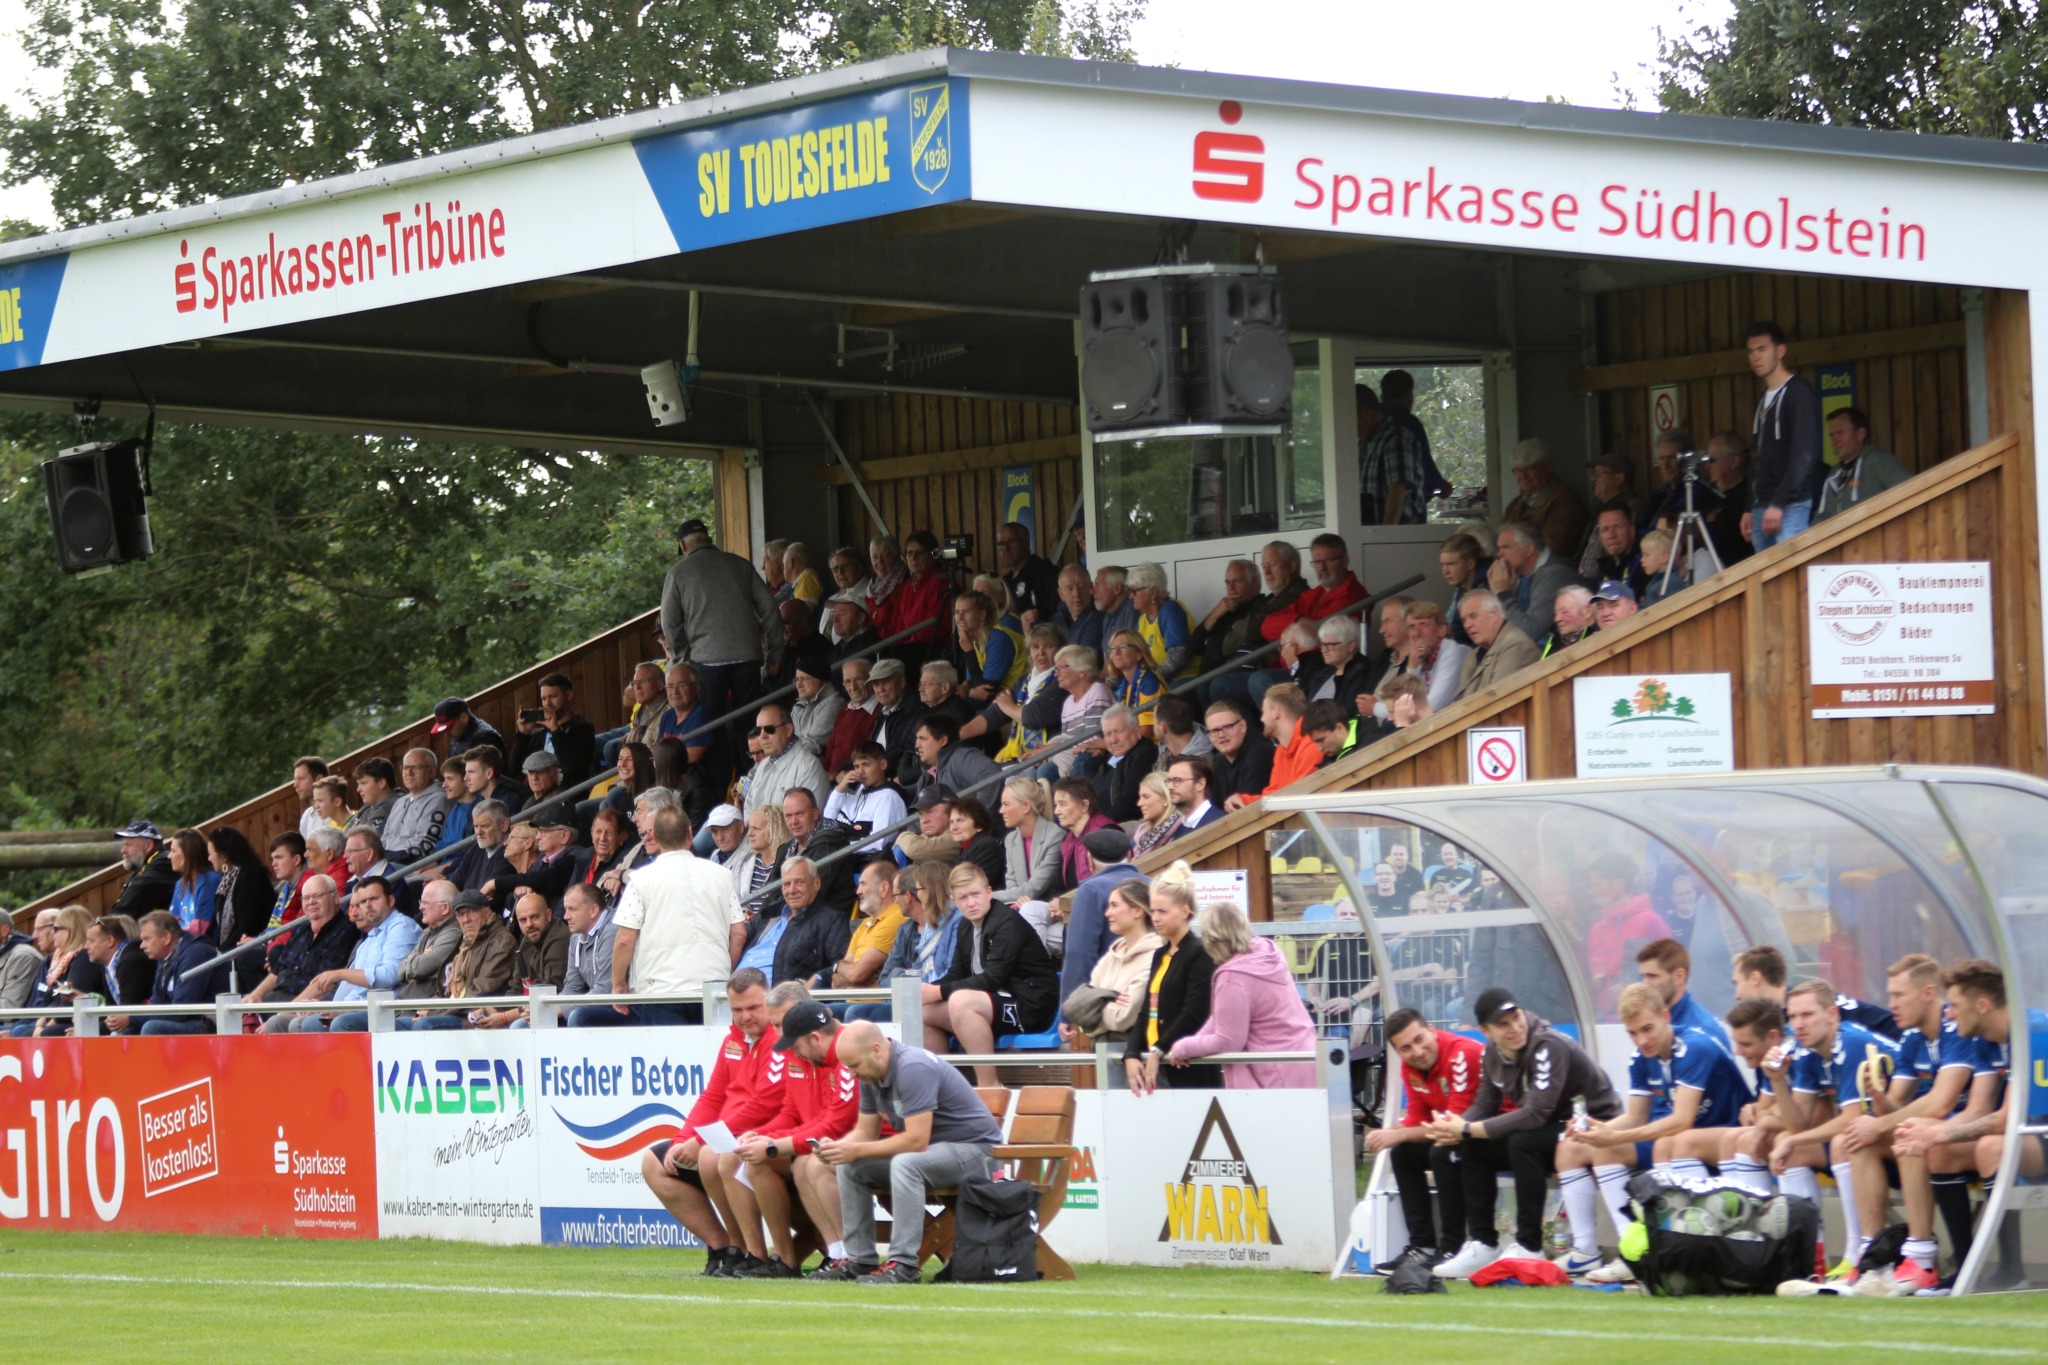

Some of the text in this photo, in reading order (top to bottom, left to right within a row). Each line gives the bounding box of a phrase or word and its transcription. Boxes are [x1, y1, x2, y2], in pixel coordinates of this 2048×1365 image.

[913, 96, 928, 118] SV
[912, 97, 947, 158] TODESFELDE
[698, 117, 890, 218] SV TODESFELDE
[924, 148, 947, 171] 1928
[1293, 157, 1927, 262] Sparkasse Südholstein
[203, 200, 506, 323] Sparkassen-Tribüne
[1007, 473, 1029, 487] Block
[1898, 575, 1984, 590] Bauklempnerei
[1818, 605, 1853, 616] Stephan
[1899, 601, 1974, 614] Bedachungen
[1900, 626, 1932, 639] Bäder
[1841, 689, 1872, 702] Mobil:
[1872, 688, 1898, 701] 0151
[1906, 687, 1920, 701] 11
[1921, 687, 1935, 701] 44
[1936, 686, 1949, 700] 88
[1951, 686, 1965, 700] 88
[1587, 746, 1704, 757] Erdarbeiten Gartenbau
[1587, 758, 1724, 770] Natursteinarbeiten Landschaftsbau
[408, 810, 446, 858] adida
[377, 1059, 524, 1114] KABEN
[540, 1056, 704, 1096] Fischer Beton
[144, 1094, 208, 1142] Besser als
[433, 1106, 534, 1168] mein Wintergarten
[147, 1134, 212, 1183] kostenlos!
[293, 1150, 346, 1180] Sparkasse
[1189, 1160, 1247, 1177] ZIMMEREI
[586, 1168, 616, 1184] Tensfeld
[294, 1187, 356, 1213] Südholstein
[383, 1196, 534, 1223] www.kaben-mein-wintergarten.de
[1074, 1193, 1098, 1204] GARTEN
[1165, 1182, 1270, 1244] WARN
[1172, 1246, 1270, 1261] Zimmermeister Olaf Warn
